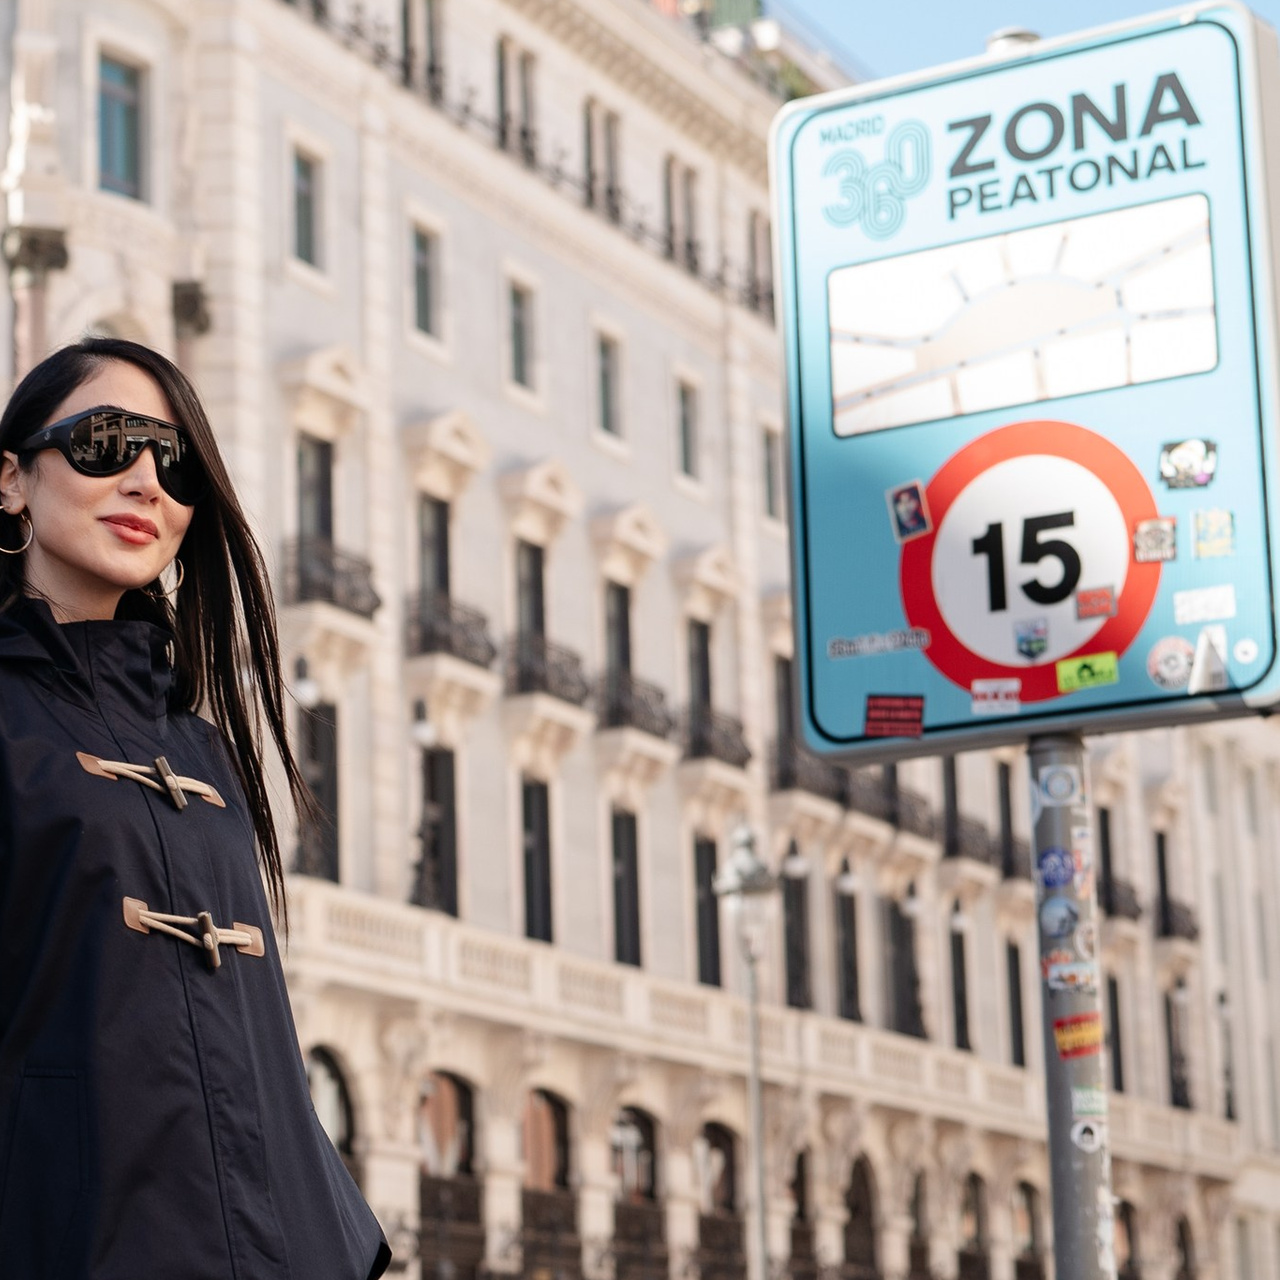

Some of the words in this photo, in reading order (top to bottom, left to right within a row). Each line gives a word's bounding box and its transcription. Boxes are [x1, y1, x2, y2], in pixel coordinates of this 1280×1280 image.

[819, 115, 884, 146] MADRID
[947, 72, 1201, 179] ZONA
[821, 119, 932, 241] 360
[947, 138, 1207, 220] PEATONAL
[972, 511, 1081, 613] 15
